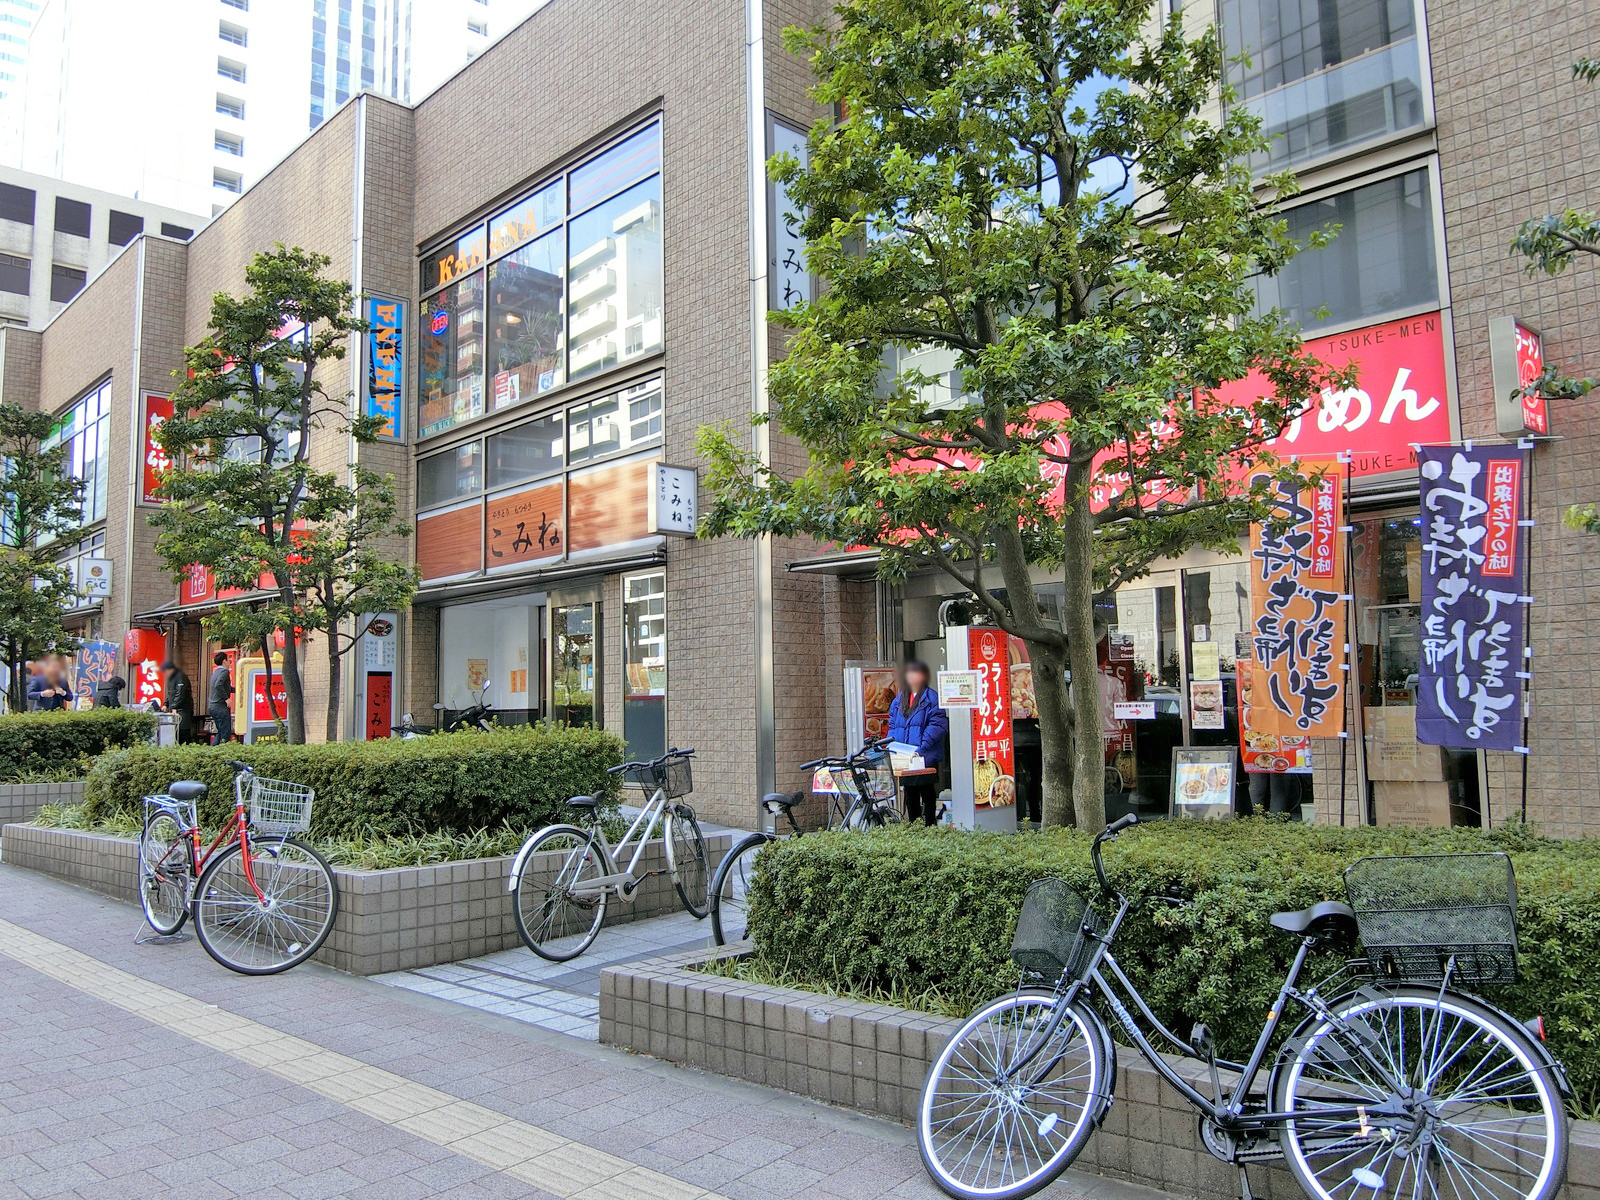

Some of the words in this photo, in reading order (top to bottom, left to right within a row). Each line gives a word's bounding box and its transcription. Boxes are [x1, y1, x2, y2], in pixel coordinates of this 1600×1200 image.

[431, 315, 449, 333] OPEN
[1328, 318, 1436, 354] TSUKE-MEN
[671, 477, 682, 523] こみね
[491, 511, 560, 558] こみね
[78, 647, 98, 697] いくら
[991, 663, 1005, 735] ラーメン
